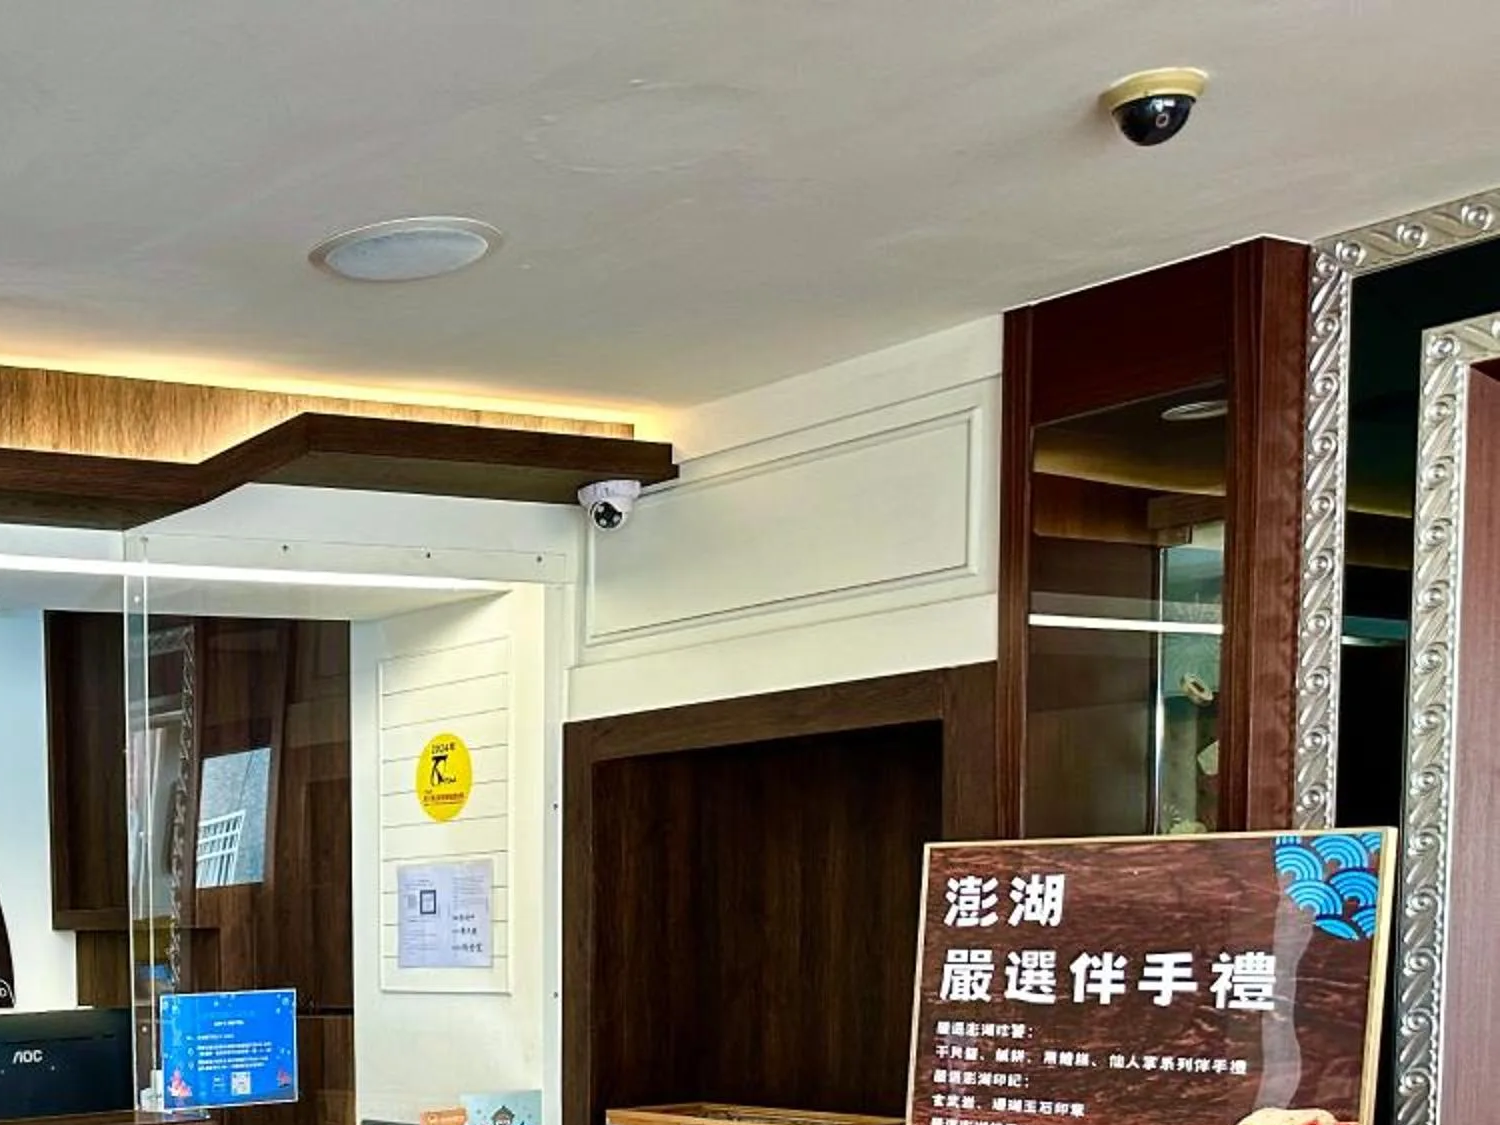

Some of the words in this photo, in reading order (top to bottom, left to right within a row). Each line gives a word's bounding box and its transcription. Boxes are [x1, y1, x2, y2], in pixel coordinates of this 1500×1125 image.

[943, 873, 1066, 929] 澎湖
[938, 948, 1277, 1011] 嚴選伴手禮
[12, 1049, 44, 1064] AOC
